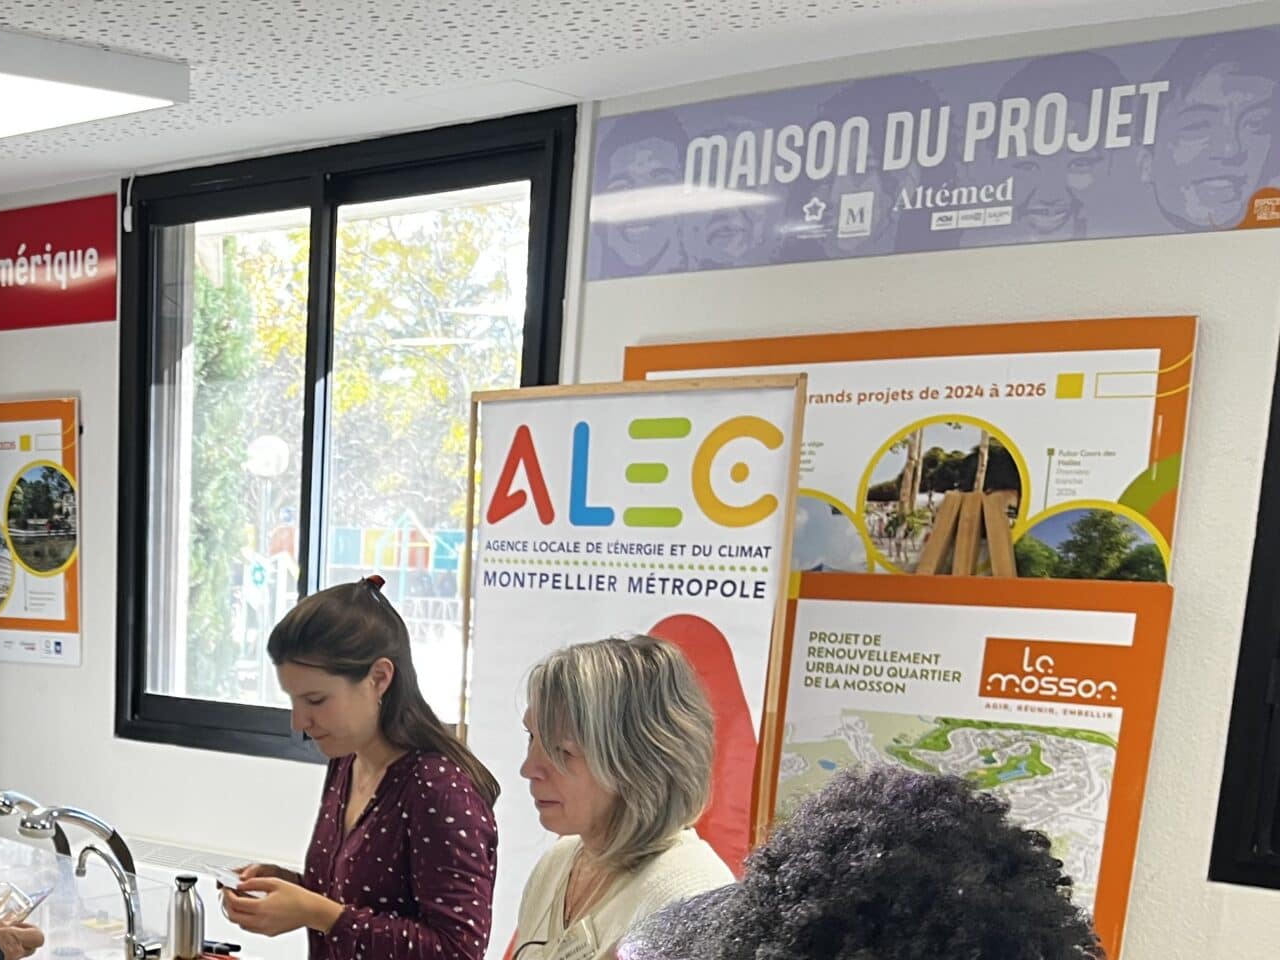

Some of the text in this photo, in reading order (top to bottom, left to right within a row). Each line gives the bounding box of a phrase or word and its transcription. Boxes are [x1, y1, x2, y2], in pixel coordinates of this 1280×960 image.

[684, 81, 1170, 193] MAISON DU PROJET
[893, 176, 1013, 211] Altémed
[846, 207, 864, 225] M
[808, 383, 1047, 406] rands projets de 2024 à 2026
[487, 415, 784, 528] ALEC
[485, 540, 528, 553] AGENCE
[533, 541, 581, 554] LOCALE
[586, 541, 603, 554] DE
[670, 544, 686, 557] ET
[691, 544, 712, 558] DU
[718, 544, 772, 559] CLIMAT
[483, 570, 767, 599] MONTPELLIER MÉTROPOLE
[808, 631, 882, 647] PROJET DE
[807, 646, 941, 666] RENOUVELLEMENT
[1022, 646, 1055, 674] la
[805, 661, 962, 683] URBAIN DU QUARTIER
[804, 676, 906, 694] DE LA MOSSON
[986, 673, 1118, 701] mosson
[1062, 708, 1114, 720] EMBELLIR
